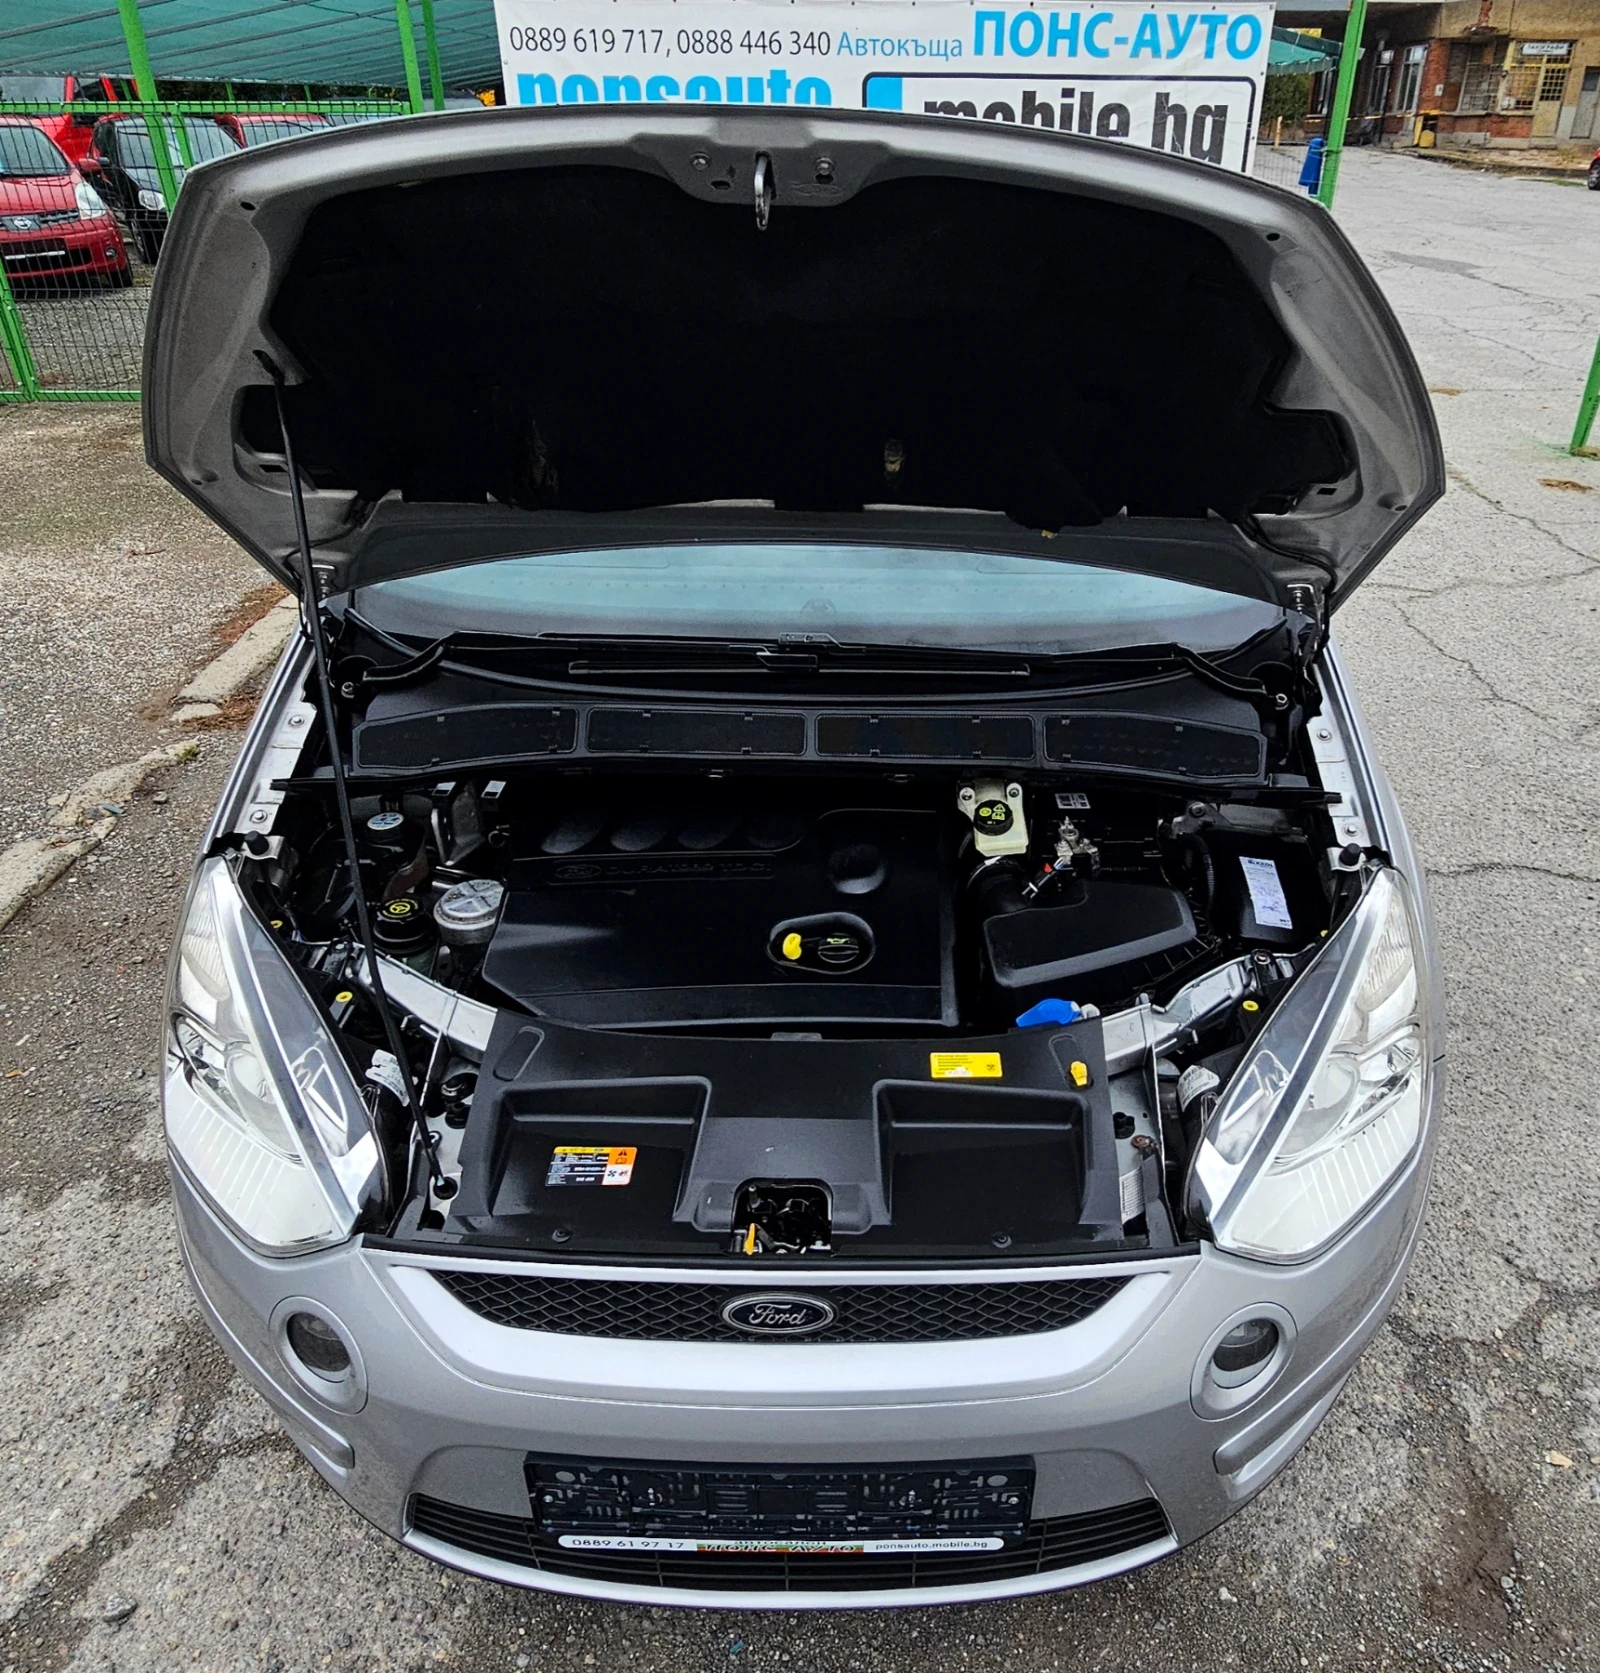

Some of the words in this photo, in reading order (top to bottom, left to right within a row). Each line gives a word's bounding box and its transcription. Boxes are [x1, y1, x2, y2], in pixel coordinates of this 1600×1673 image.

[509, 26, 567, 52] 0889
[573, 28, 616, 53] 619
[621, 29, 670, 58] 717,
[677, 29, 733, 55] 0888
[739, 30, 782, 56] 446
[789, 30, 831, 56] 340
[836, 31, 963, 62] Автокъща
[973, 10, 1263, 60] ПОНС-АУТО
[748, 1302, 808, 1325] Ford
[572, 1539, 611, 1547] 0889
[617, 1540, 634, 1548] 61
[641, 1541, 659, 1549] 97
[875, 1540, 988, 1551] ponsauto.mobile.bg
